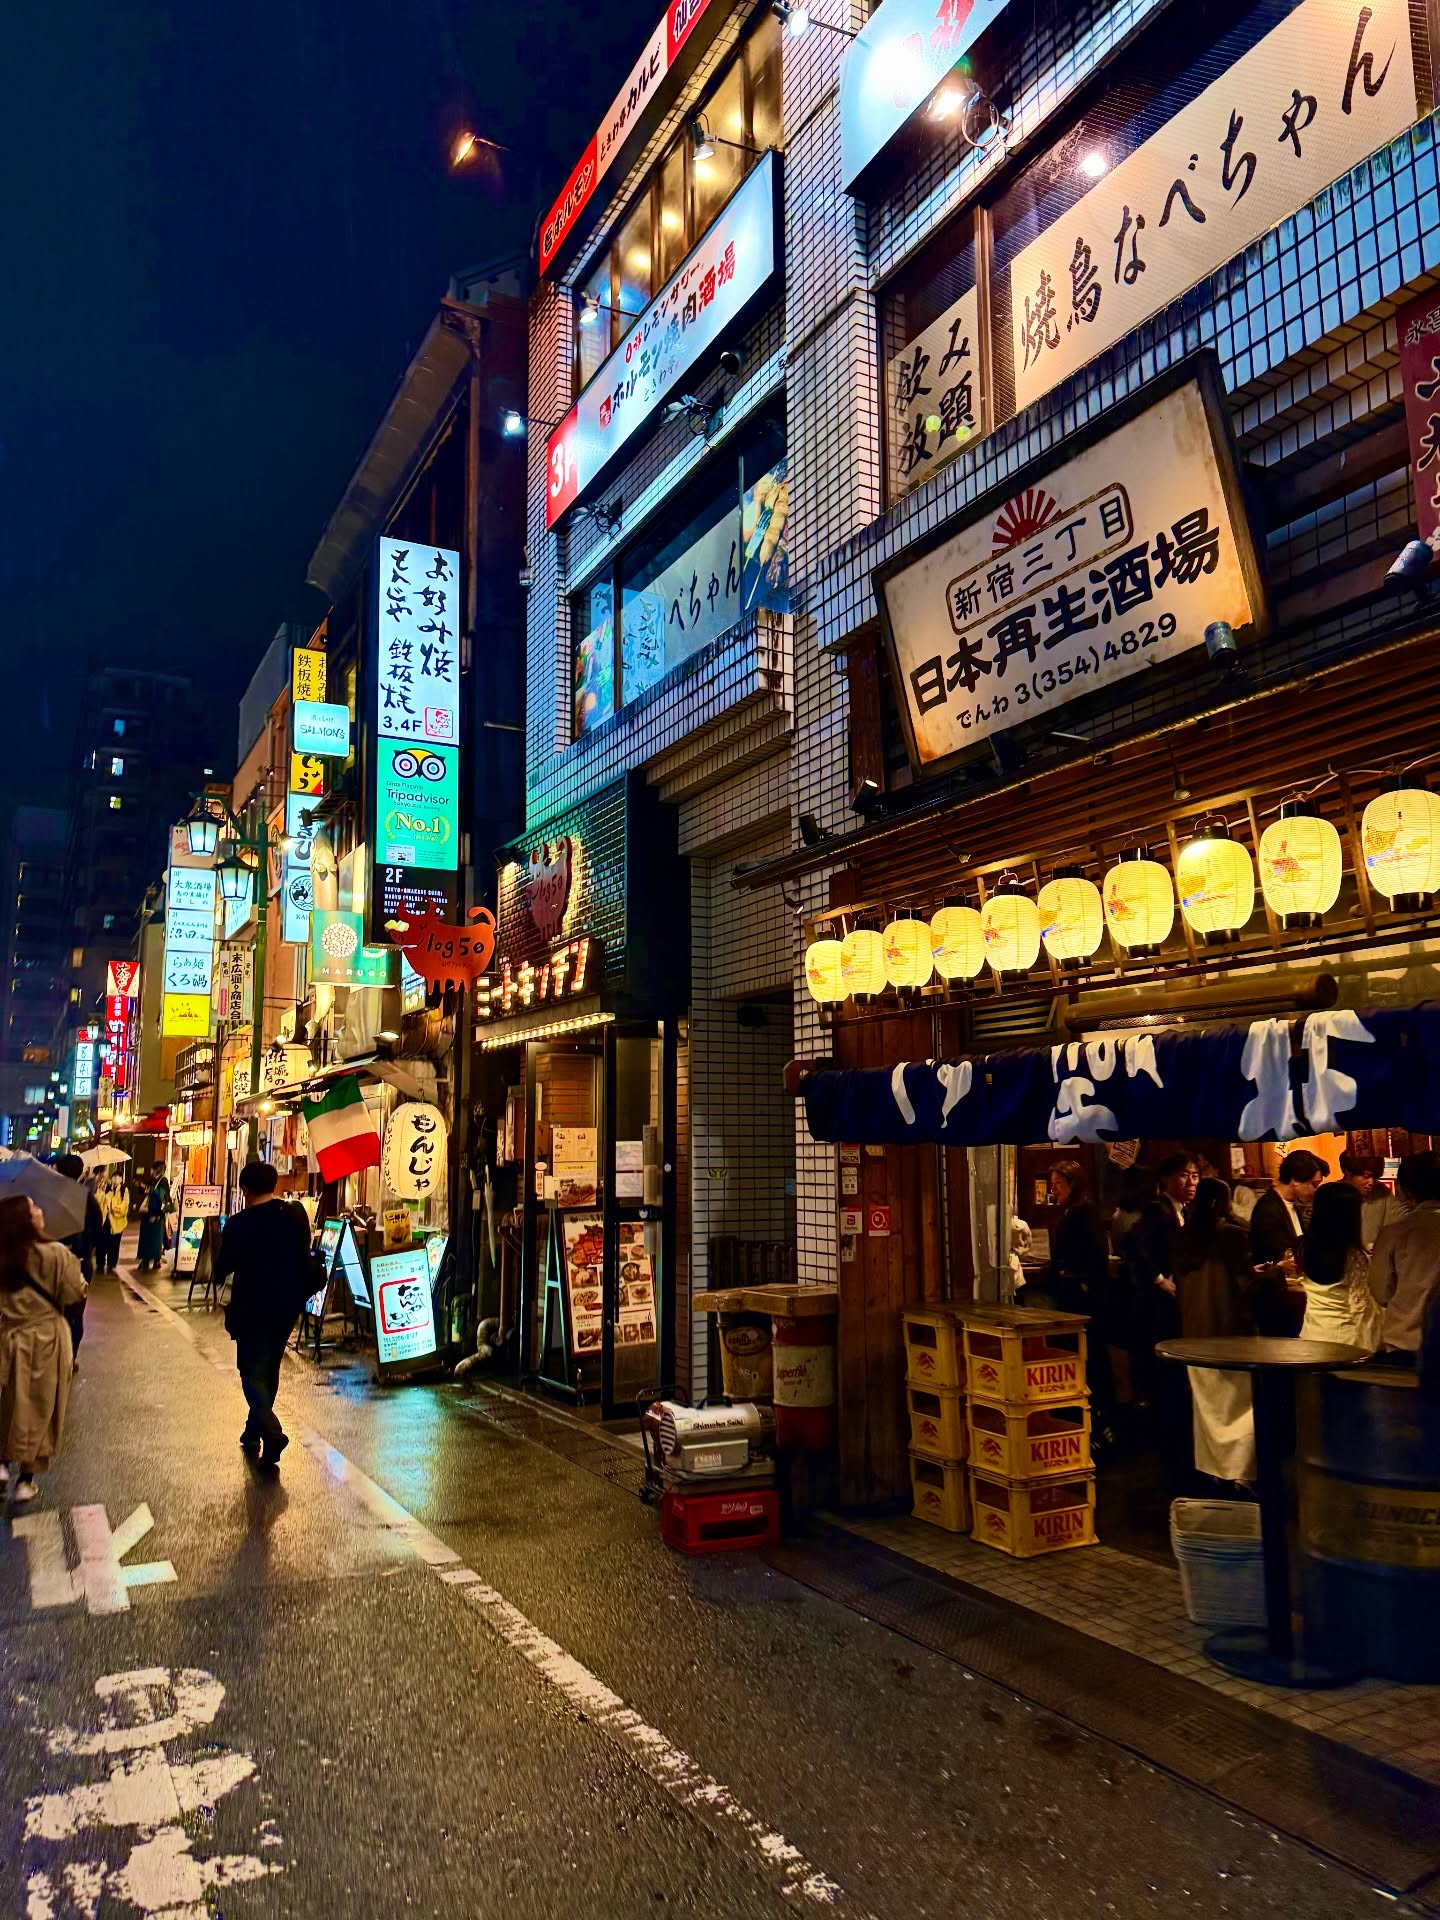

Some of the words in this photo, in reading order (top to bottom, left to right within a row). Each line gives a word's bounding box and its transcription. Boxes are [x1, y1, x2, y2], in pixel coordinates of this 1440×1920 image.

[1020, 6, 1399, 373] 焼鳥なべちゃん
[612, 240, 737, 414] ホルモン焼肉酒場
[385, 549, 413, 623] もんじゃ
[954, 496, 1125, 620] 新宿三丁目
[413, 550, 455, 683] お好み焼
[909, 507, 1220, 716] 日本再生酒場
[297, 653, 312, 700] 鉄板焼
[380, 637, 416, 715] 鉄板焼
[956, 692, 1010, 729] でんわ
[1013, 612, 1178, 704] 3(354)4829
[382, 715, 423, 733] 3,4F
[386, 788, 450, 805] Tripadvisor
[395, 812, 441, 834] No.1
[385, 867, 404, 884] 2F
[230, 952, 243, 1021] 末広通り商店会
[322, 967, 386, 977] MARUGO
[409, 1114, 437, 1191] もんじゃ
[1026, 1362, 1076, 1387] KIRIN
[1030, 1436, 1081, 1462] KIRIN
[1034, 1510, 1084, 1538] KIRIN
